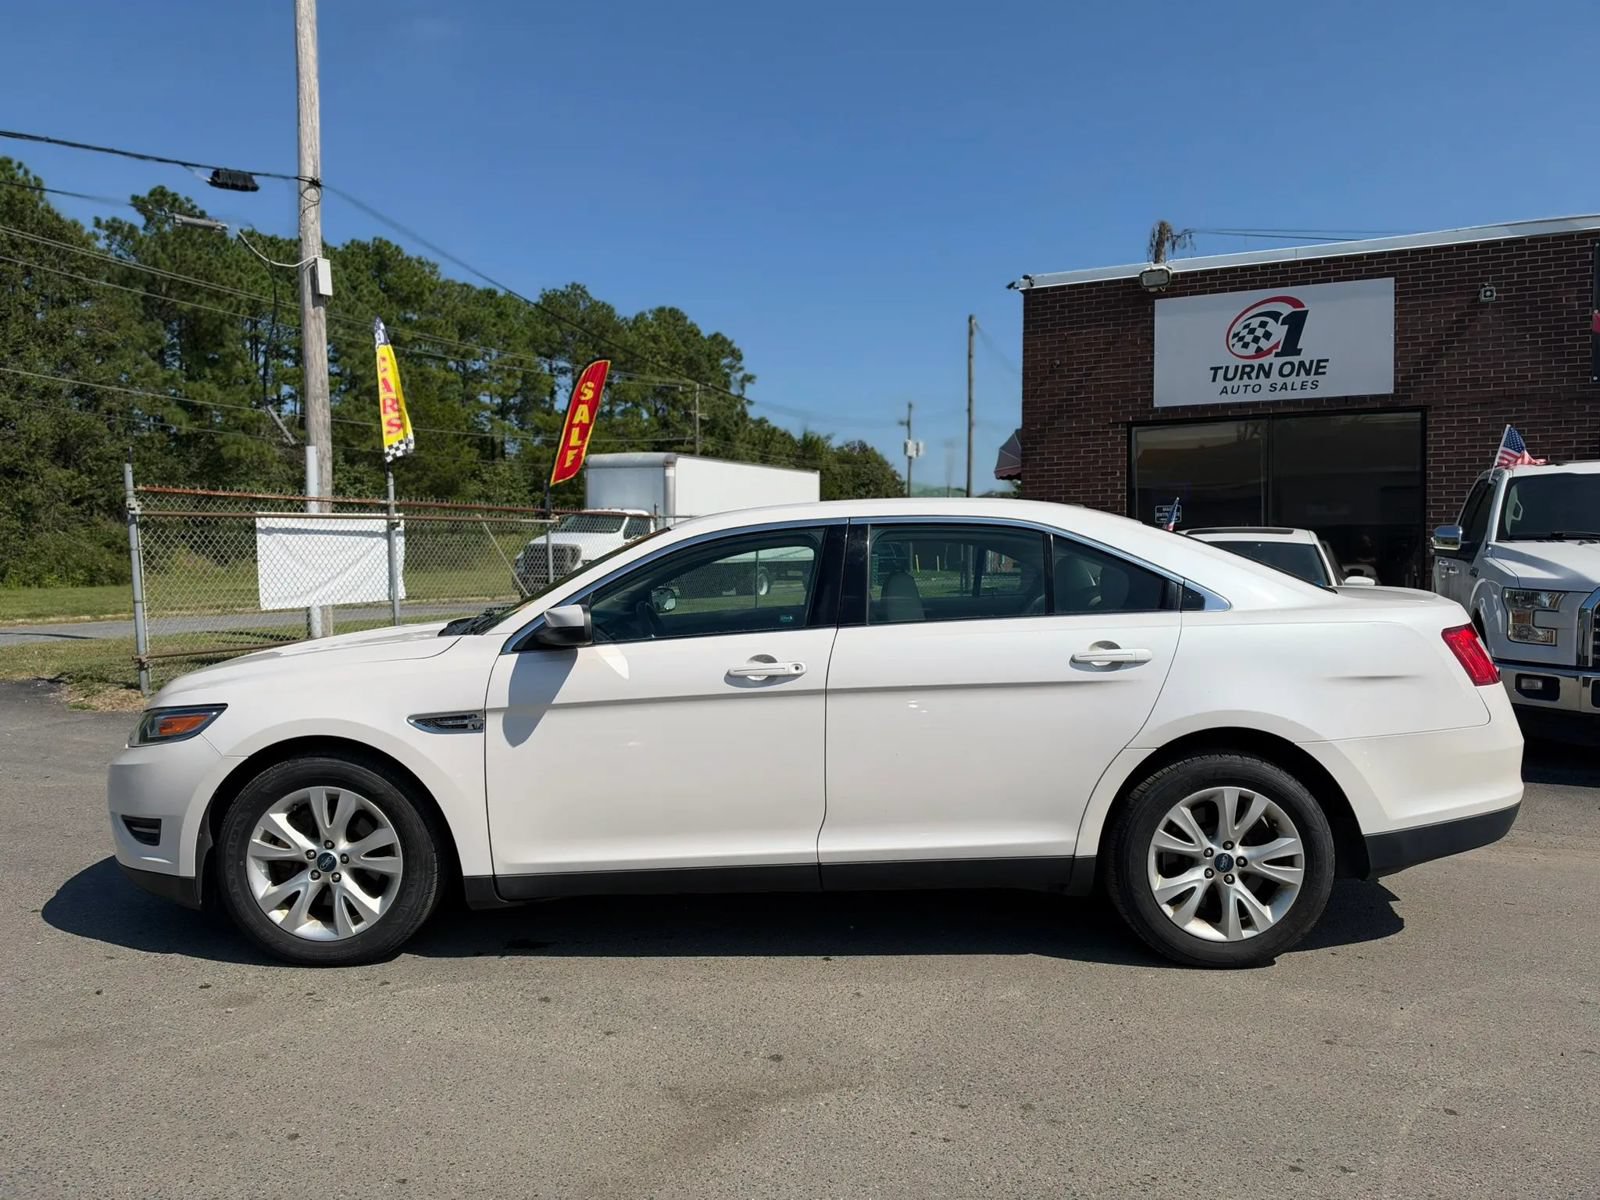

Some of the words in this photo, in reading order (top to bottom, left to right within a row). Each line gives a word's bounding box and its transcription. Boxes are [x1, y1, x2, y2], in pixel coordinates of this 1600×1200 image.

[1274, 309, 1309, 358] 1
[1209, 362, 1274, 383] TURN
[1278, 358, 1329, 378] ONE
[1219, 383, 1262, 396] AUTO
[1269, 380, 1320, 393] SALES
[378, 355, 404, 436] CARS
[564, 381, 595, 469] SALE
